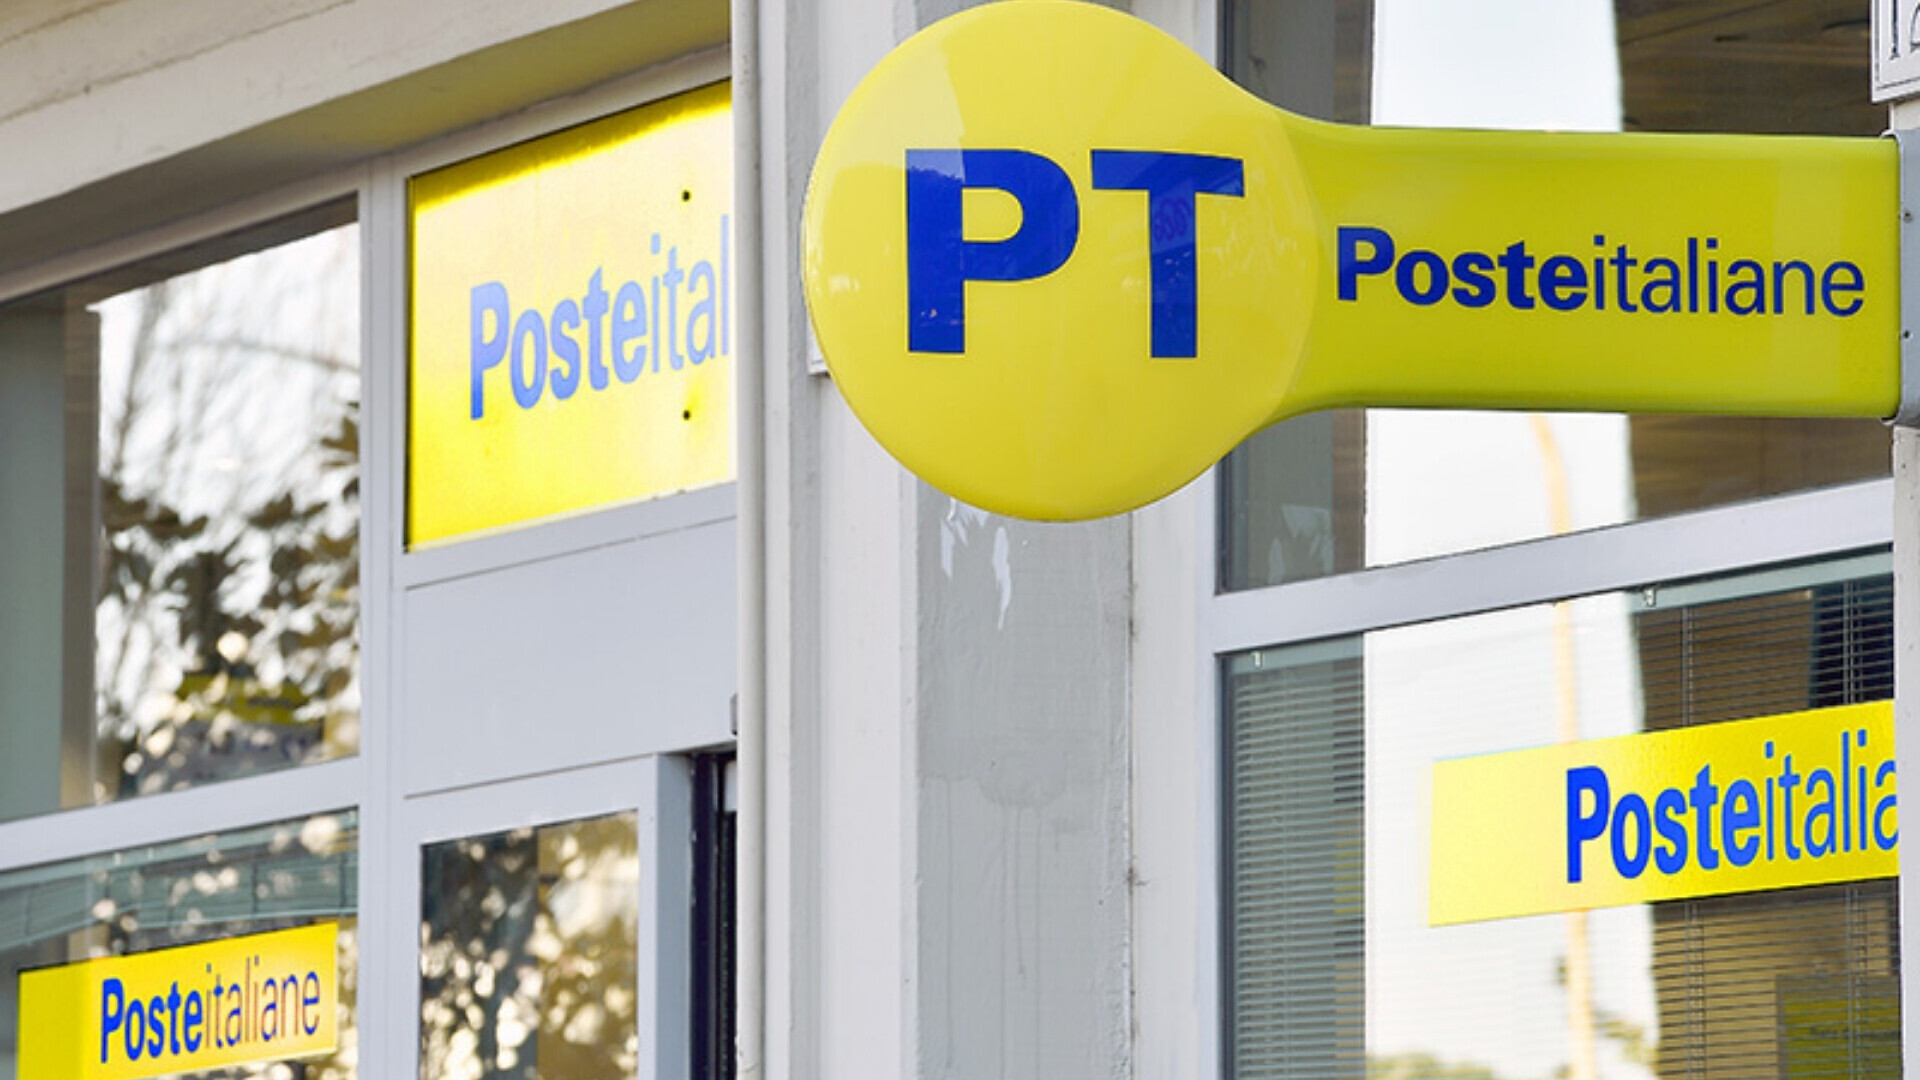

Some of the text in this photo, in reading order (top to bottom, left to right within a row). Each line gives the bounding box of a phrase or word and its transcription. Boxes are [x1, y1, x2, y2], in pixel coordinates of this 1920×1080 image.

[905, 148, 1245, 359] PT
[1337, 225, 1865, 317] Posteitaliane
[1566, 728, 1898, 884] Posteitalia
[100, 954, 321, 1064] Posteitaliane
